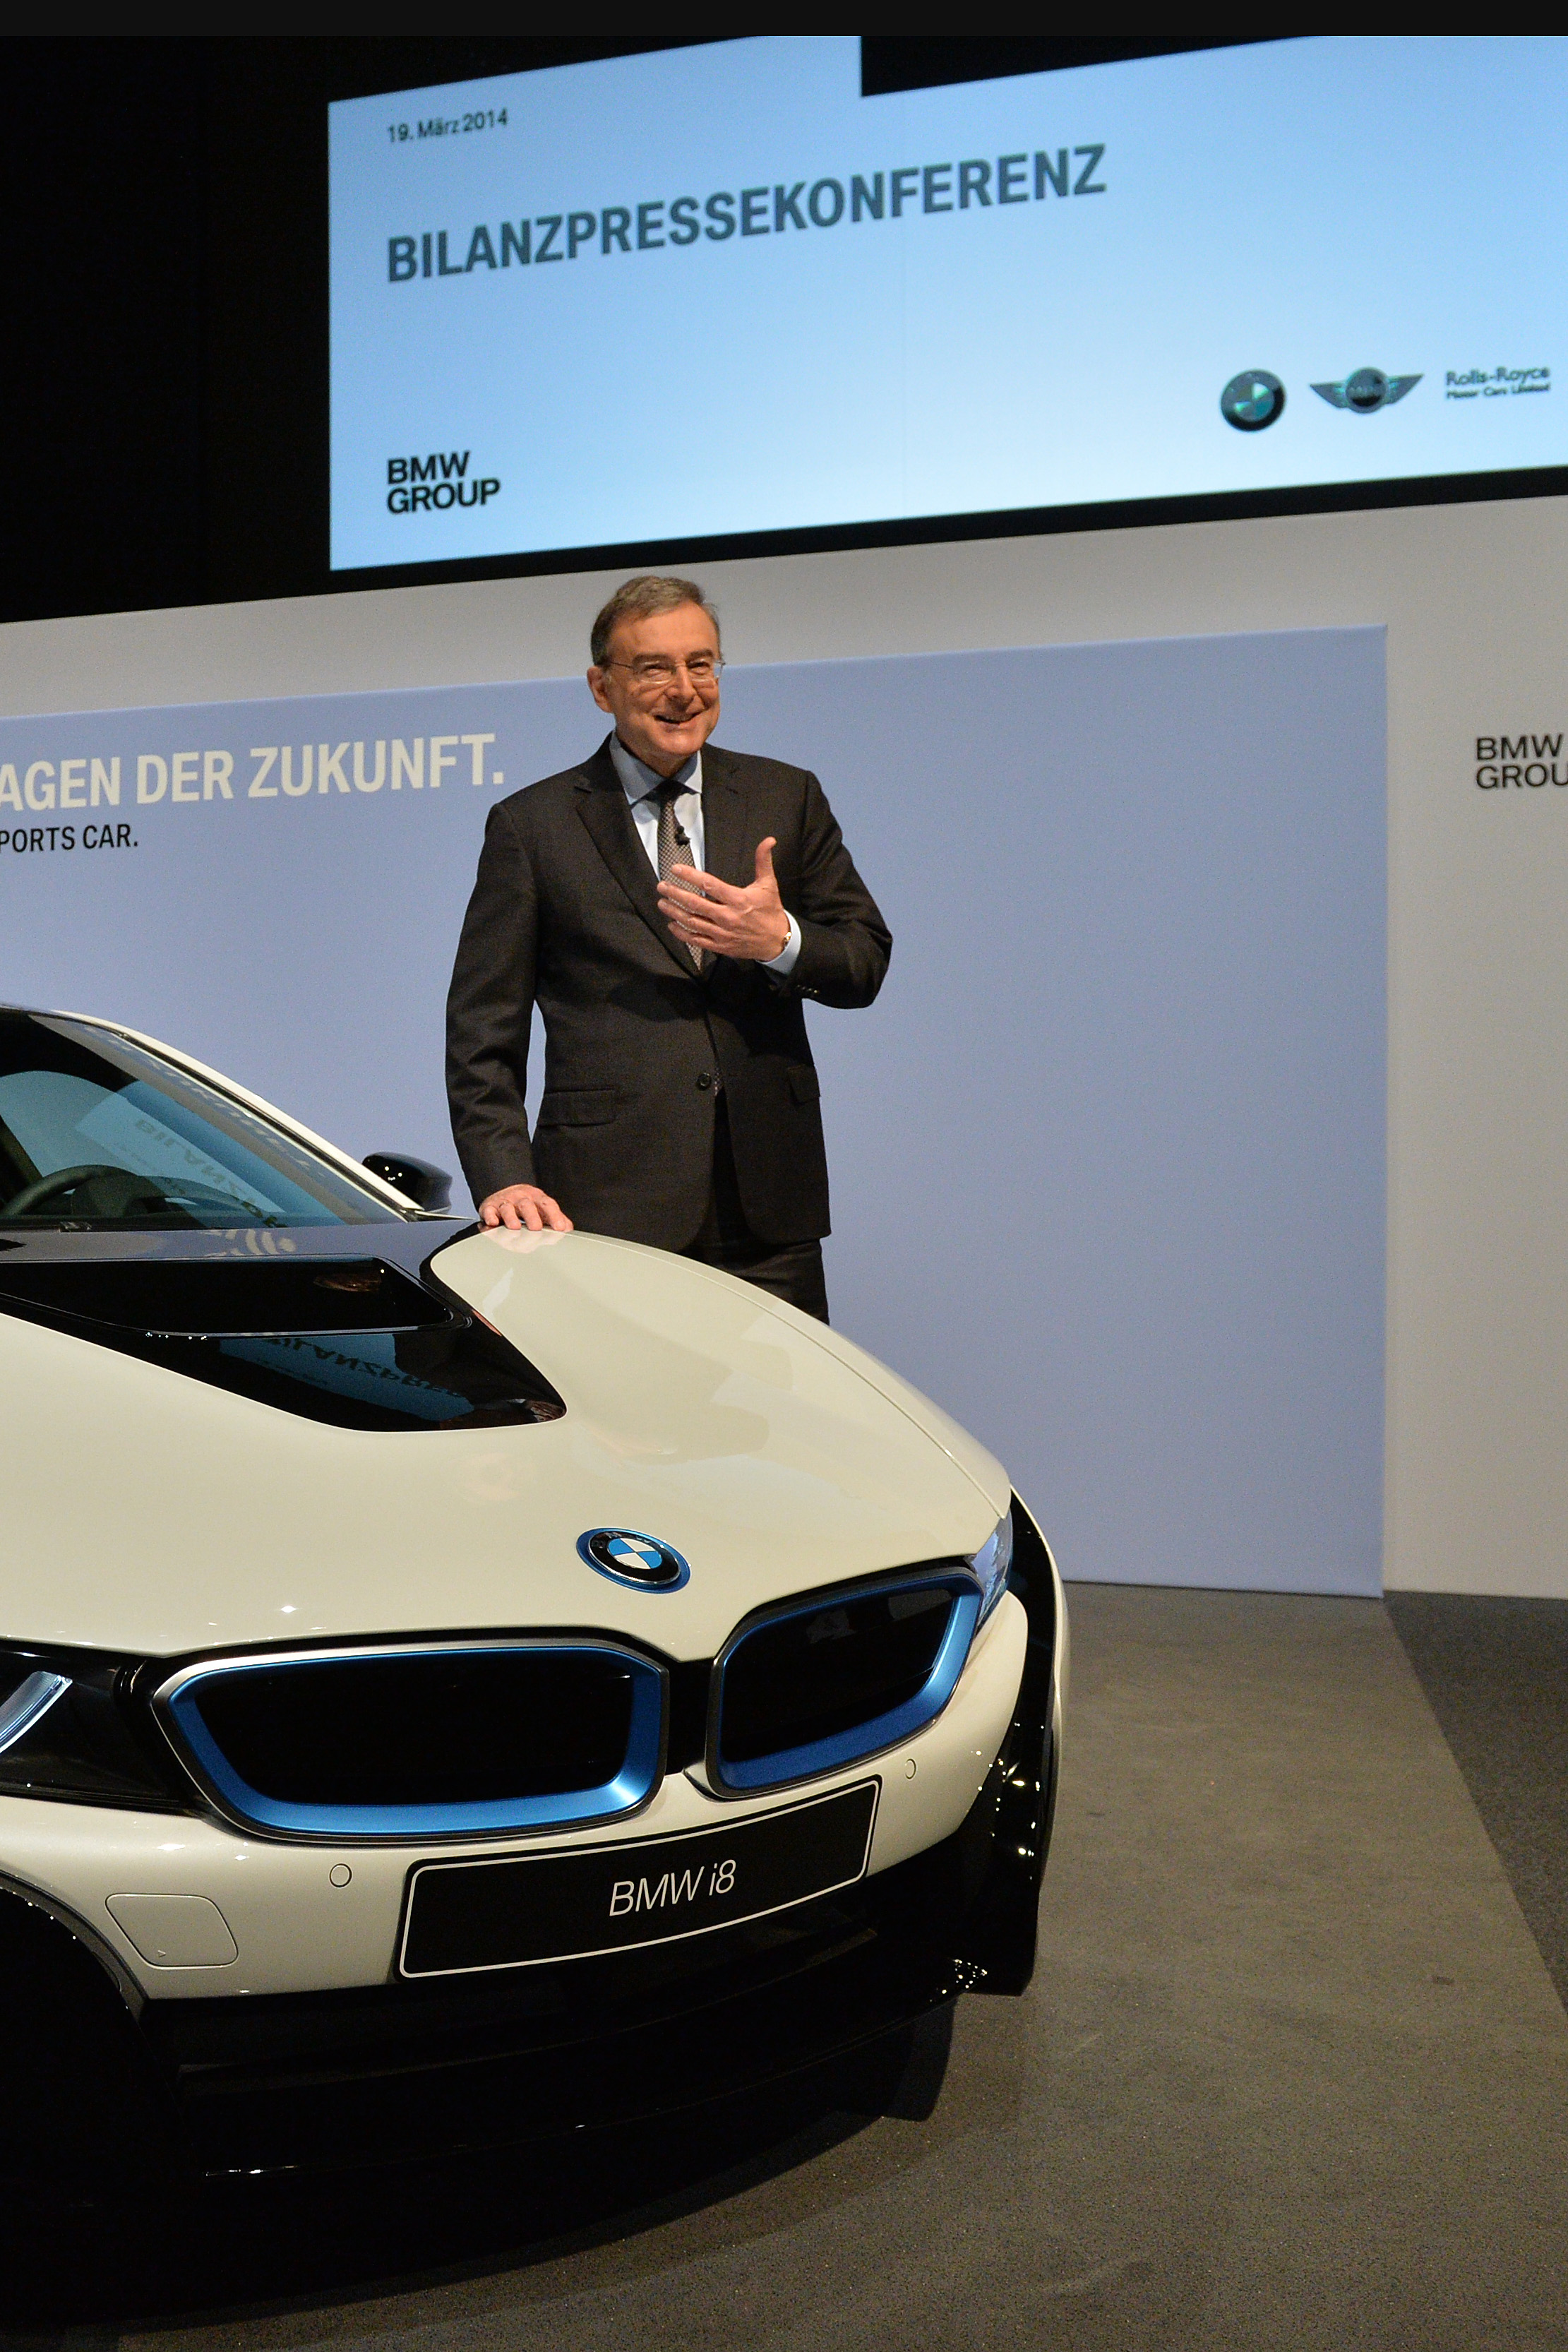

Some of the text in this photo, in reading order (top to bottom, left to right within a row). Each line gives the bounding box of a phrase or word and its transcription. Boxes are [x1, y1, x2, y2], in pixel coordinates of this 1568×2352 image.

[388, 107, 508, 142] 19. März 2014
[388, 143, 1107, 282] BILANZPRESSEKONFERENZ
[388, 450, 470, 484] BMW
[387, 477, 501, 513] GROUP
[1476, 733, 1564, 760] BMW
[0, 733, 503, 811] AGEN DER ZUKUNFT.
[1476, 763, 1568, 789] GROU
[83, 823, 138, 849] CAR.
[609, 1859, 736, 1916] BMW i8
